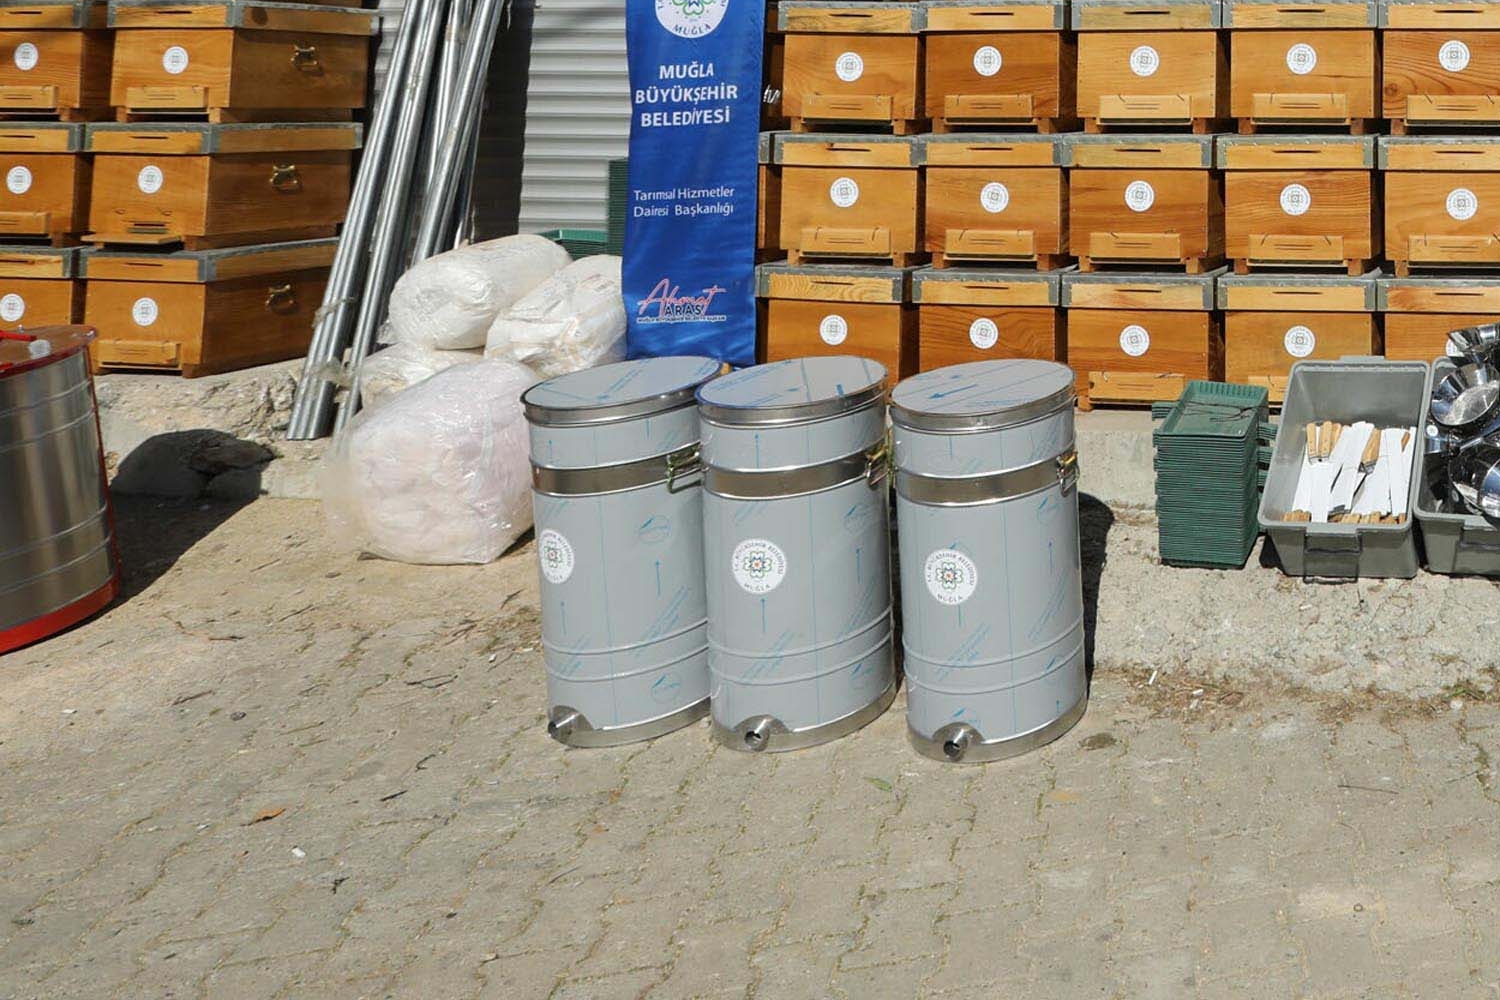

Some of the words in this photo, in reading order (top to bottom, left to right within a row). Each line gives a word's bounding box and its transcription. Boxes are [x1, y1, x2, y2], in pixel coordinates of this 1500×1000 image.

[673, 22, 711, 35] MUĞLA
[659, 60, 714, 80] MUĞLA
[635, 81, 738, 105] BÜYÜKŞEHİR
[640, 105, 731, 127] BELEDİYESİ
[633, 188, 676, 201] Tarımsal
[677, 185, 735, 200] Hizmetler
[633, 204, 670, 218] Dairesi
[674, 201, 734, 218] Başkanlığı
[665, 304, 702, 316] ARAS
